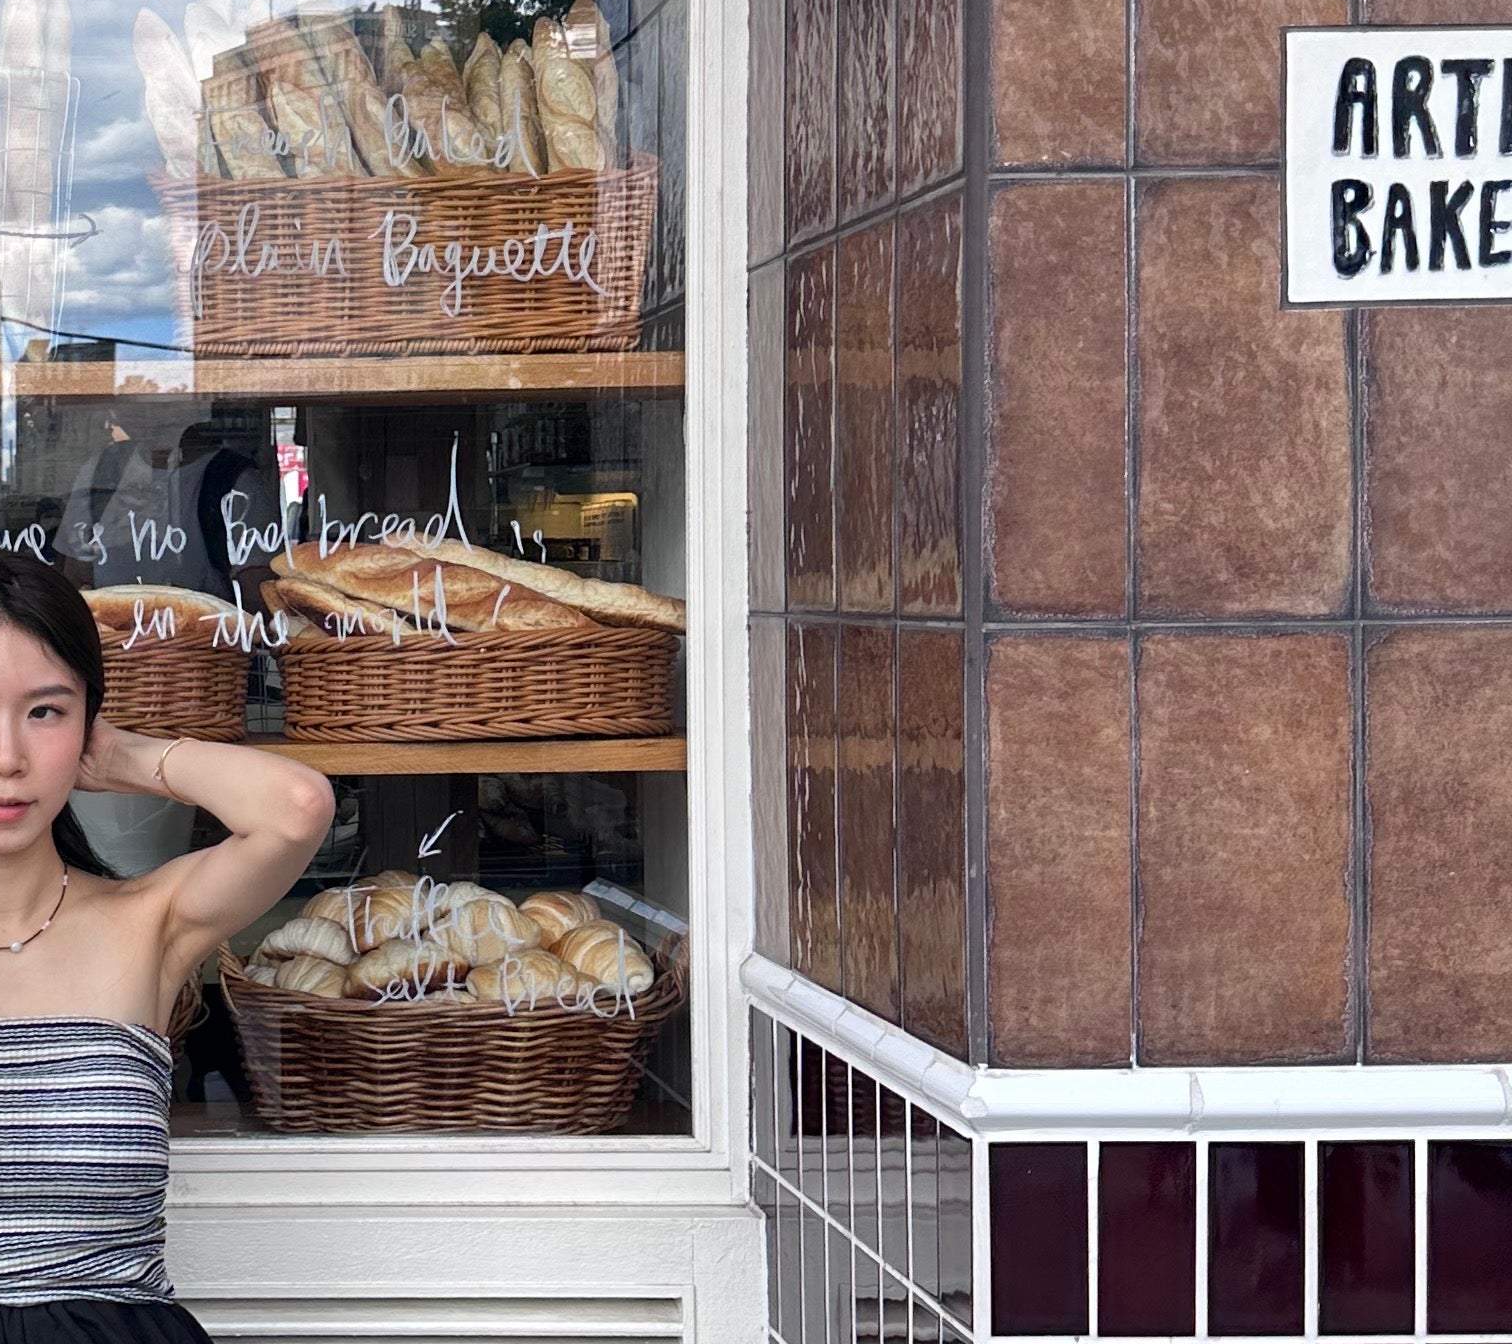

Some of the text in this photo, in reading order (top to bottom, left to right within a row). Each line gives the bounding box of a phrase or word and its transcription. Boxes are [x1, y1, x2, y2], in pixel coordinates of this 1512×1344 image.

[1331, 54, 1512, 159] ARTI
[368, 209, 615, 318] Baguette
[1330, 177, 1512, 279] BAKE
[127, 510, 187, 562] no
[317, 430, 474, 560] bread
